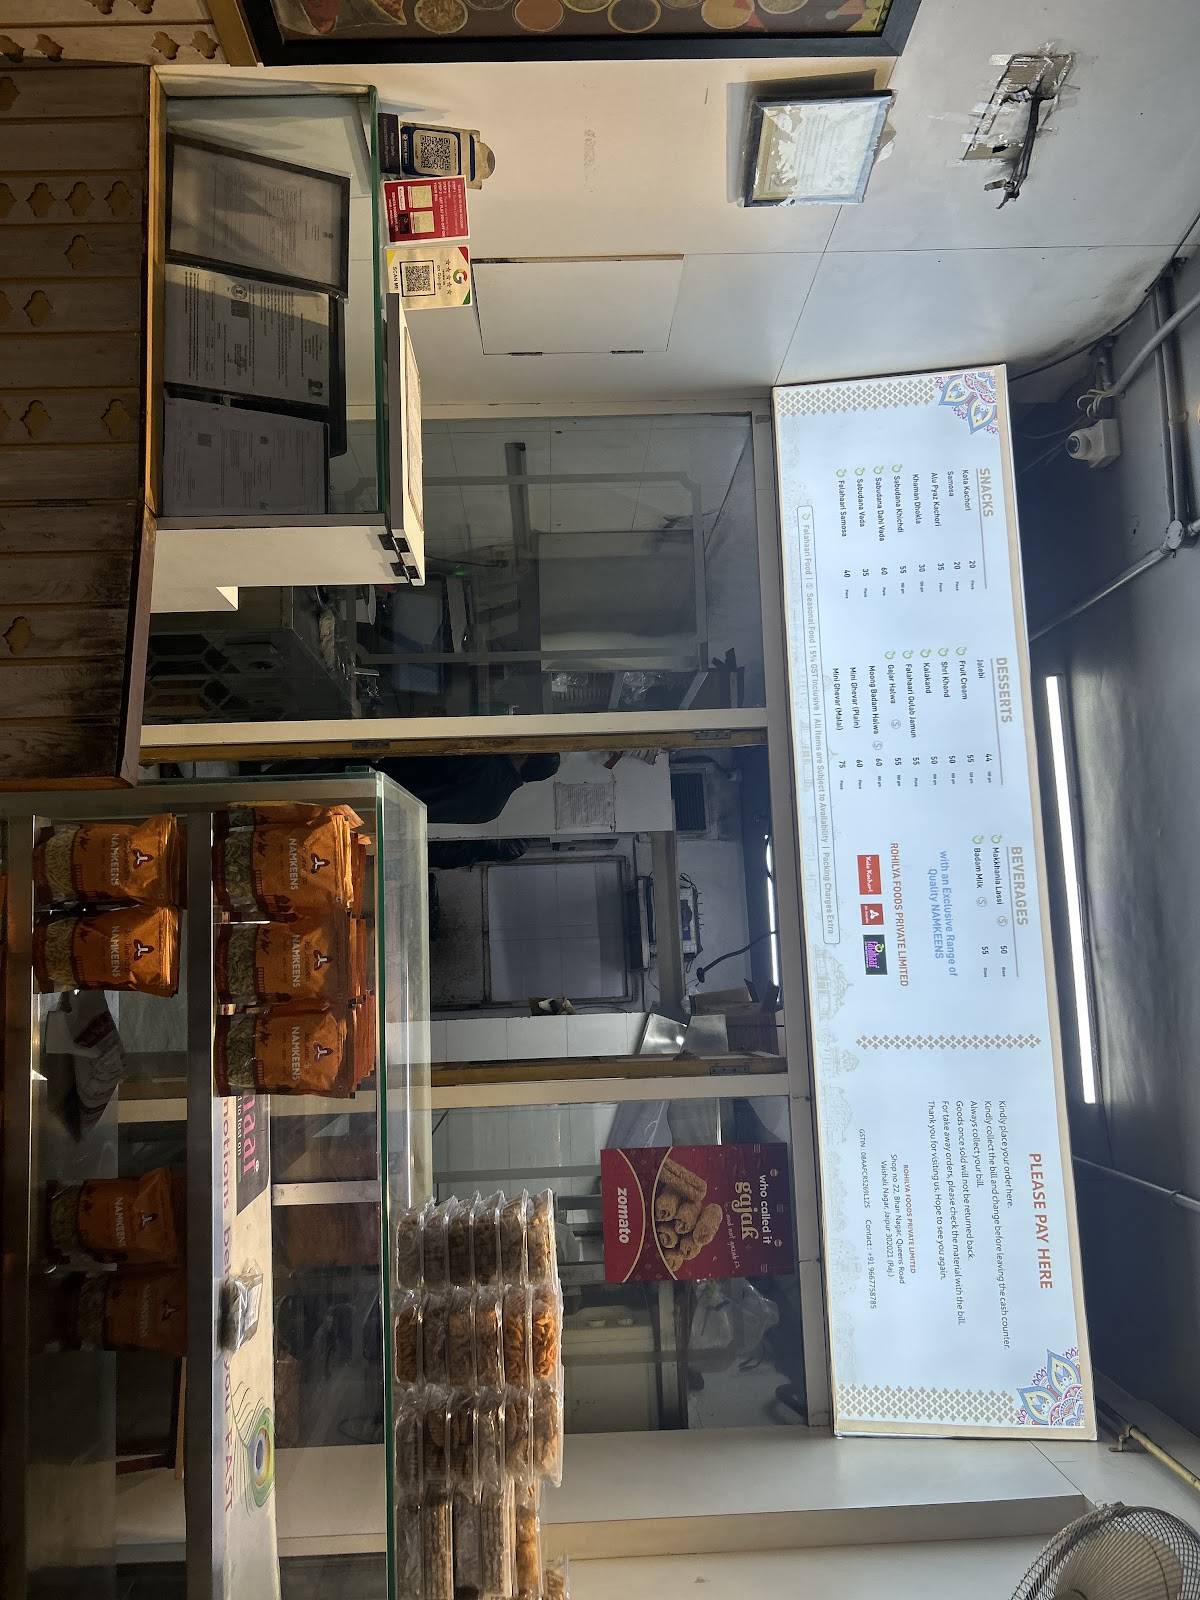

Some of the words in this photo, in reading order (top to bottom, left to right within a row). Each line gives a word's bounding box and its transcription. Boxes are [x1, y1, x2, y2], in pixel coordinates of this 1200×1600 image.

[838, 480, 846, 510] Falahaari
[856, 479, 864, 510] Sabudana
[979, 468, 994, 517] SNACKS
[896, 509, 904, 533] Khichdi
[900, 566, 906, 574] 55
[914, 502, 922, 524] Dhokla
[918, 564, 925, 572] 30
[933, 502, 941, 526] Kachori
[937, 563, 944, 571] 35
[881, 567, 888, 575] 60
[954, 562, 961, 570] 20
[969, 561, 976, 569] 20
[832, 668, 840, 682] Mini
[849, 667, 857, 681] Mini
[867, 666, 875, 687] Moong
[941, 661, 949, 675] Shri
[850, 683, 858, 705] Ghevar
[942, 677, 950, 698] Khand
[996, 658, 1012, 723] DESSERTS
[870, 689, 878, 712] Badam
[977, 660, 985, 678] Jalebi
[985, 754, 992, 762] 44
[835, 708, 843, 730] (Malai)
[852, 707, 860, 729] (Plain)
[886, 665, 895, 681] Gajar
[894, 758, 901, 766] 55
[905, 664, 913, 694] Falahaari
[913, 757, 920, 766] 55
[923, 663, 932, 694] Kalakand
[930, 756, 938, 764] 50
[960, 678, 968, 700] Cream
[966, 755, 974, 763] 55
[838, 761, 846, 769] 75
[856, 760, 863, 768] 60
[110, 832, 121, 887] NAMKEENS
[288, 838, 300, 890] NAMKEENS
[890, 843, 901, 879] ROHILYA
[940, 851, 950, 871] with
[992, 848, 1001, 884] Makkhania
[927, 869, 939, 902] Quality
[941, 874, 949, 885] an
[1011, 847, 1028, 926] BEVERAGES
[893, 881, 903, 910] FOODS
[973, 848, 981, 872] Badam
[981, 946, 989, 954] 55
[995, 886, 1003, 904] Lassi
[942, 888, 953, 932] Exclusive
[895, 913, 906, 949] PRIVATE
[931, 904, 943, 959] NAMKEENS
[110, 925, 121, 978] NAMKEENS
[290, 934, 302, 988] NAMKEENS
[945, 935, 955, 964] Range
[1000, 946, 1008, 954] 50
[898, 951, 908, 987] LIMITED
[948, 967, 958, 976] of
[290, 1026, 302, 1081] NAMKEENS
[942, 1115, 950, 1131] take
[956, 1101, 964, 1126] Goods
[969, 1101, 978, 1127] Always
[983, 1101, 993, 1125] Kindly
[998, 1100, 1007, 1125] Kindly
[972, 1129, 980, 1154] collect
[986, 1126, 994, 1151] collect
[999, 1126, 1008, 1147] place
[889, 1154, 897, 1172] Shop
[959, 1147, 968, 1163] sold
[972, 1155, 981, 1173] your
[988, 1153, 996, 1165] the
[1000, 1147, 1009, 1165] your
[892, 1174, 897, 1183] no
[961, 1165, 969, 1178] will
[989, 1167, 997, 1179] bill
[1004, 1166, 1012, 1188] order
[1029, 1154, 1046, 1209] PLEASE
[759, 1175, 768, 1198] who
[946, 1181, 956, 1206] please
[963, 1194, 971, 1204] be
[990, 1180, 999, 1195] and
[114, 1197, 127, 1248] NAMKEENS
[618, 1187, 632, 1244] zomato
[732, 1182, 758, 1240] gajak
[760, 1200, 771, 1232] called
[950, 1207, 959, 1229] check
[964, 1205, 974, 1239] returned
[991, 1196, 1000, 1225] change
[762, 1236, 772, 1244] it
[994, 1226, 1003, 1252] before
[1034, 1215, 1049, 1243] PAY
[895, 1239, 903, 1265] Queens
[953, 1245, 962, 1277] material
[996, 1253, 1005, 1282] leaving
[1037, 1249, 1052, 1289] HERE
[955, 1278, 963, 1295] with
[998, 1283, 1006, 1296] the
[956, 1297, 964, 1310] the
[1000, 1298, 1008, 1316] cash
[224, 1428, 233, 1512] FAST
